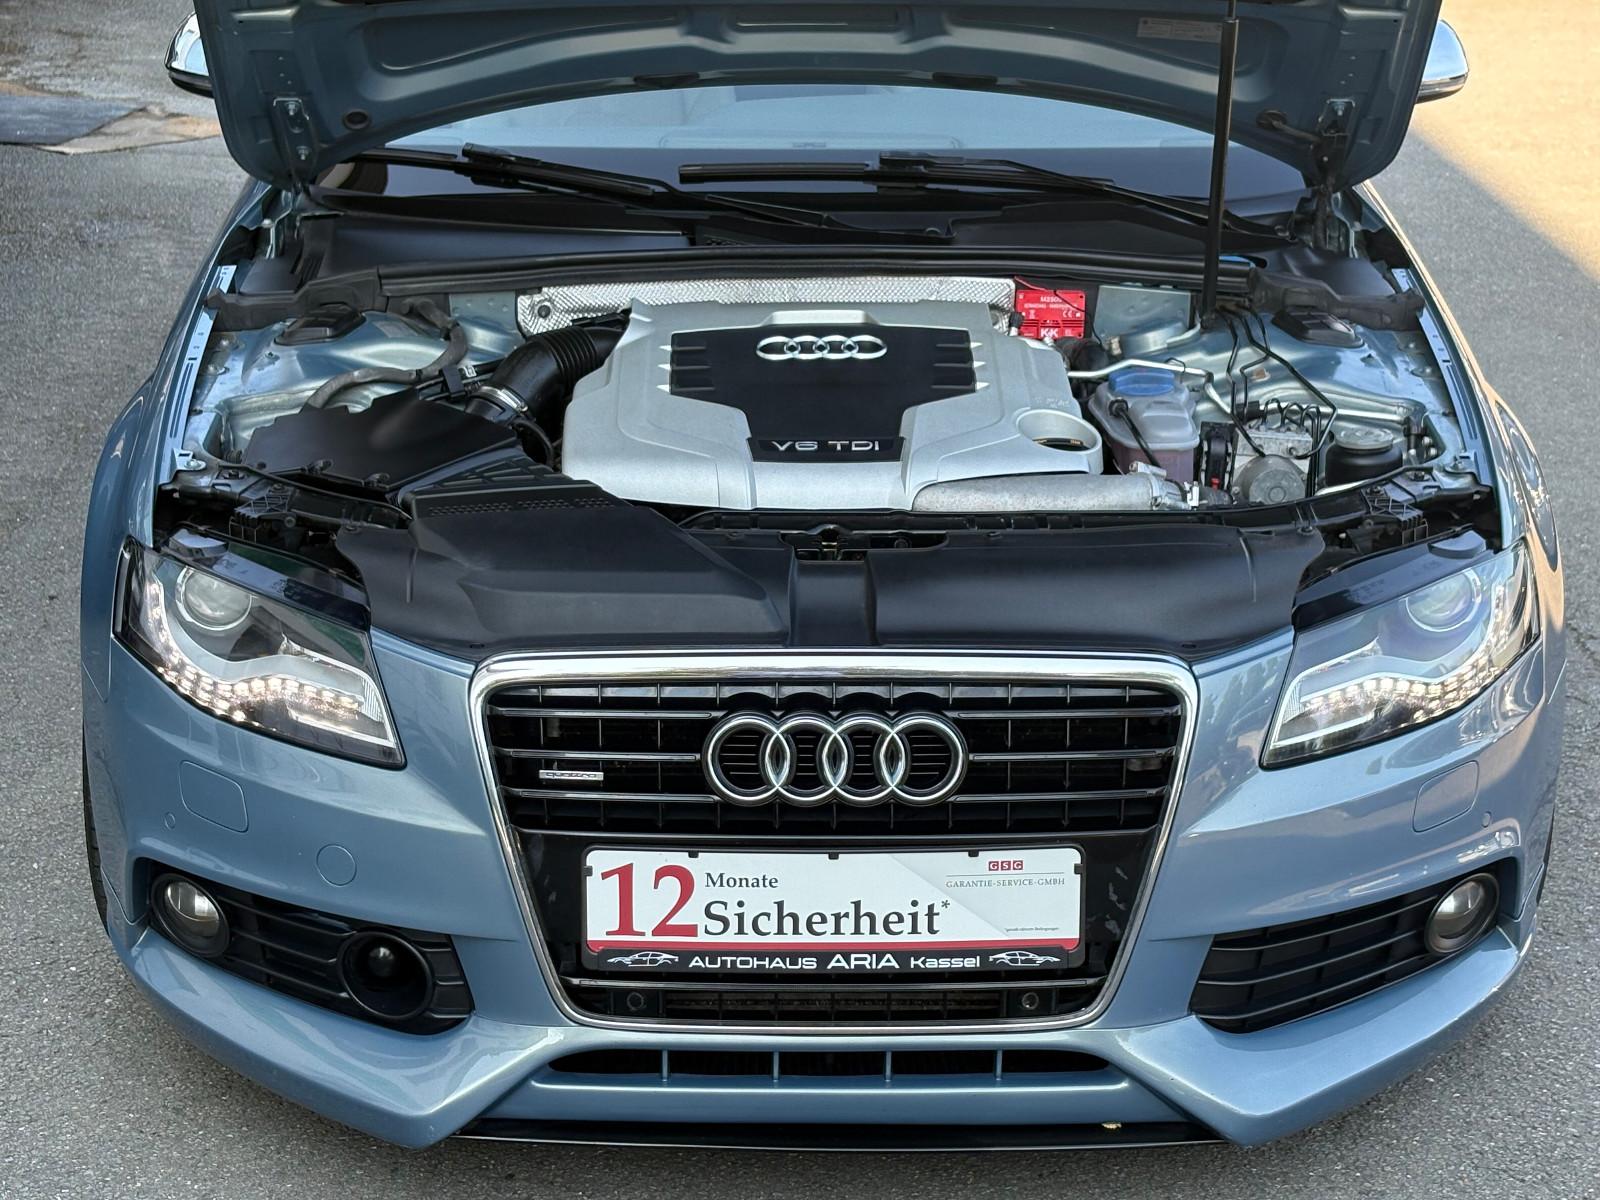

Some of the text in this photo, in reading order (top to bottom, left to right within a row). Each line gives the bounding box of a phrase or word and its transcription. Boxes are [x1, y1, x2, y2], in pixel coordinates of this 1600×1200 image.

[771, 440, 880, 452] V6 TDI
[989, 861, 1023, 871] GSG
[704, 872, 779, 888] Monate
[600, 862, 699, 938] 12
[688, 953, 981, 969] AUTOHAUS ARIA Kassel
